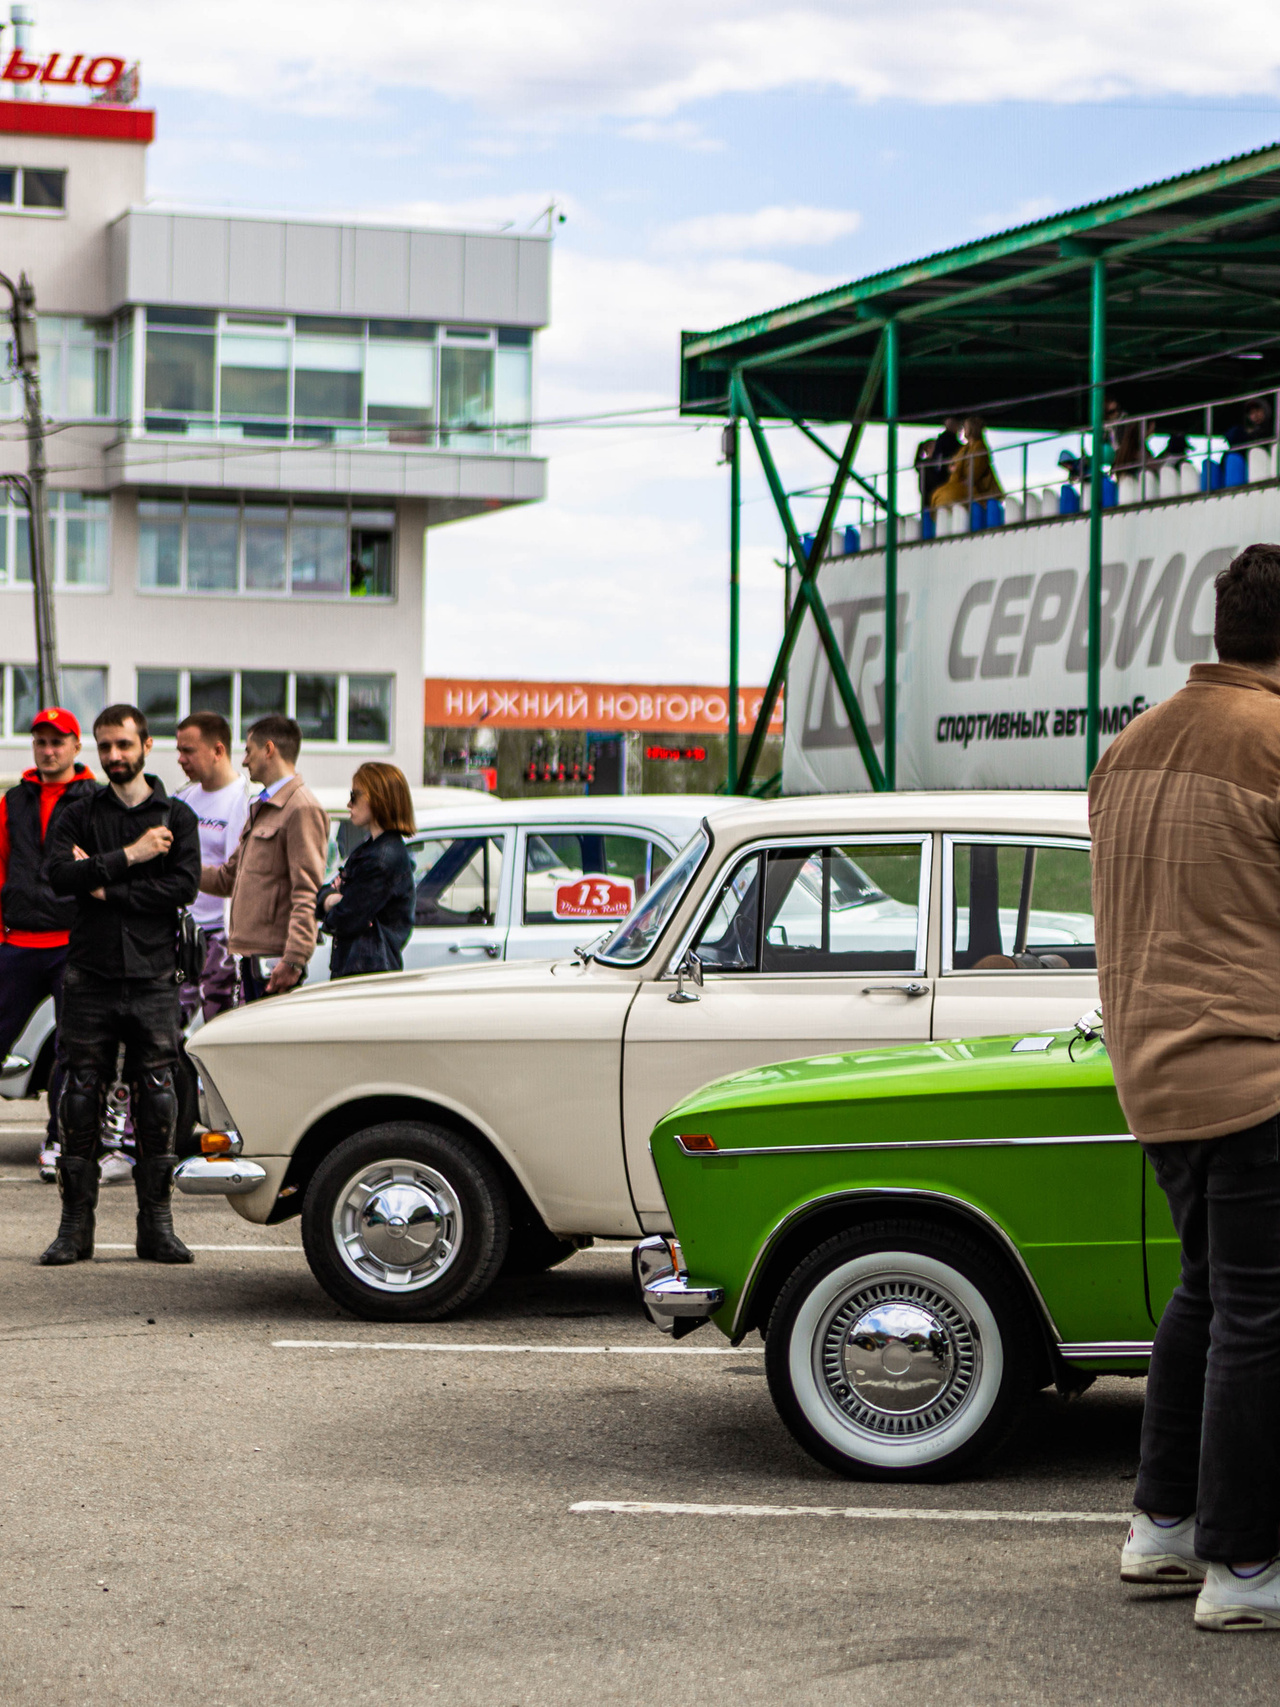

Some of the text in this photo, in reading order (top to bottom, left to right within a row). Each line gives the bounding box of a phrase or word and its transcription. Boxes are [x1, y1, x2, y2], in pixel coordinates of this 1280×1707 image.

[948, 546, 1239, 682] СЕРВИС
[445, 686, 588, 719] НИЖНИЙ
[936, 711, 1049, 749] спортивных
[560, 900, 628, 916] Vintage Rally
[578, 884, 611, 906] 13
